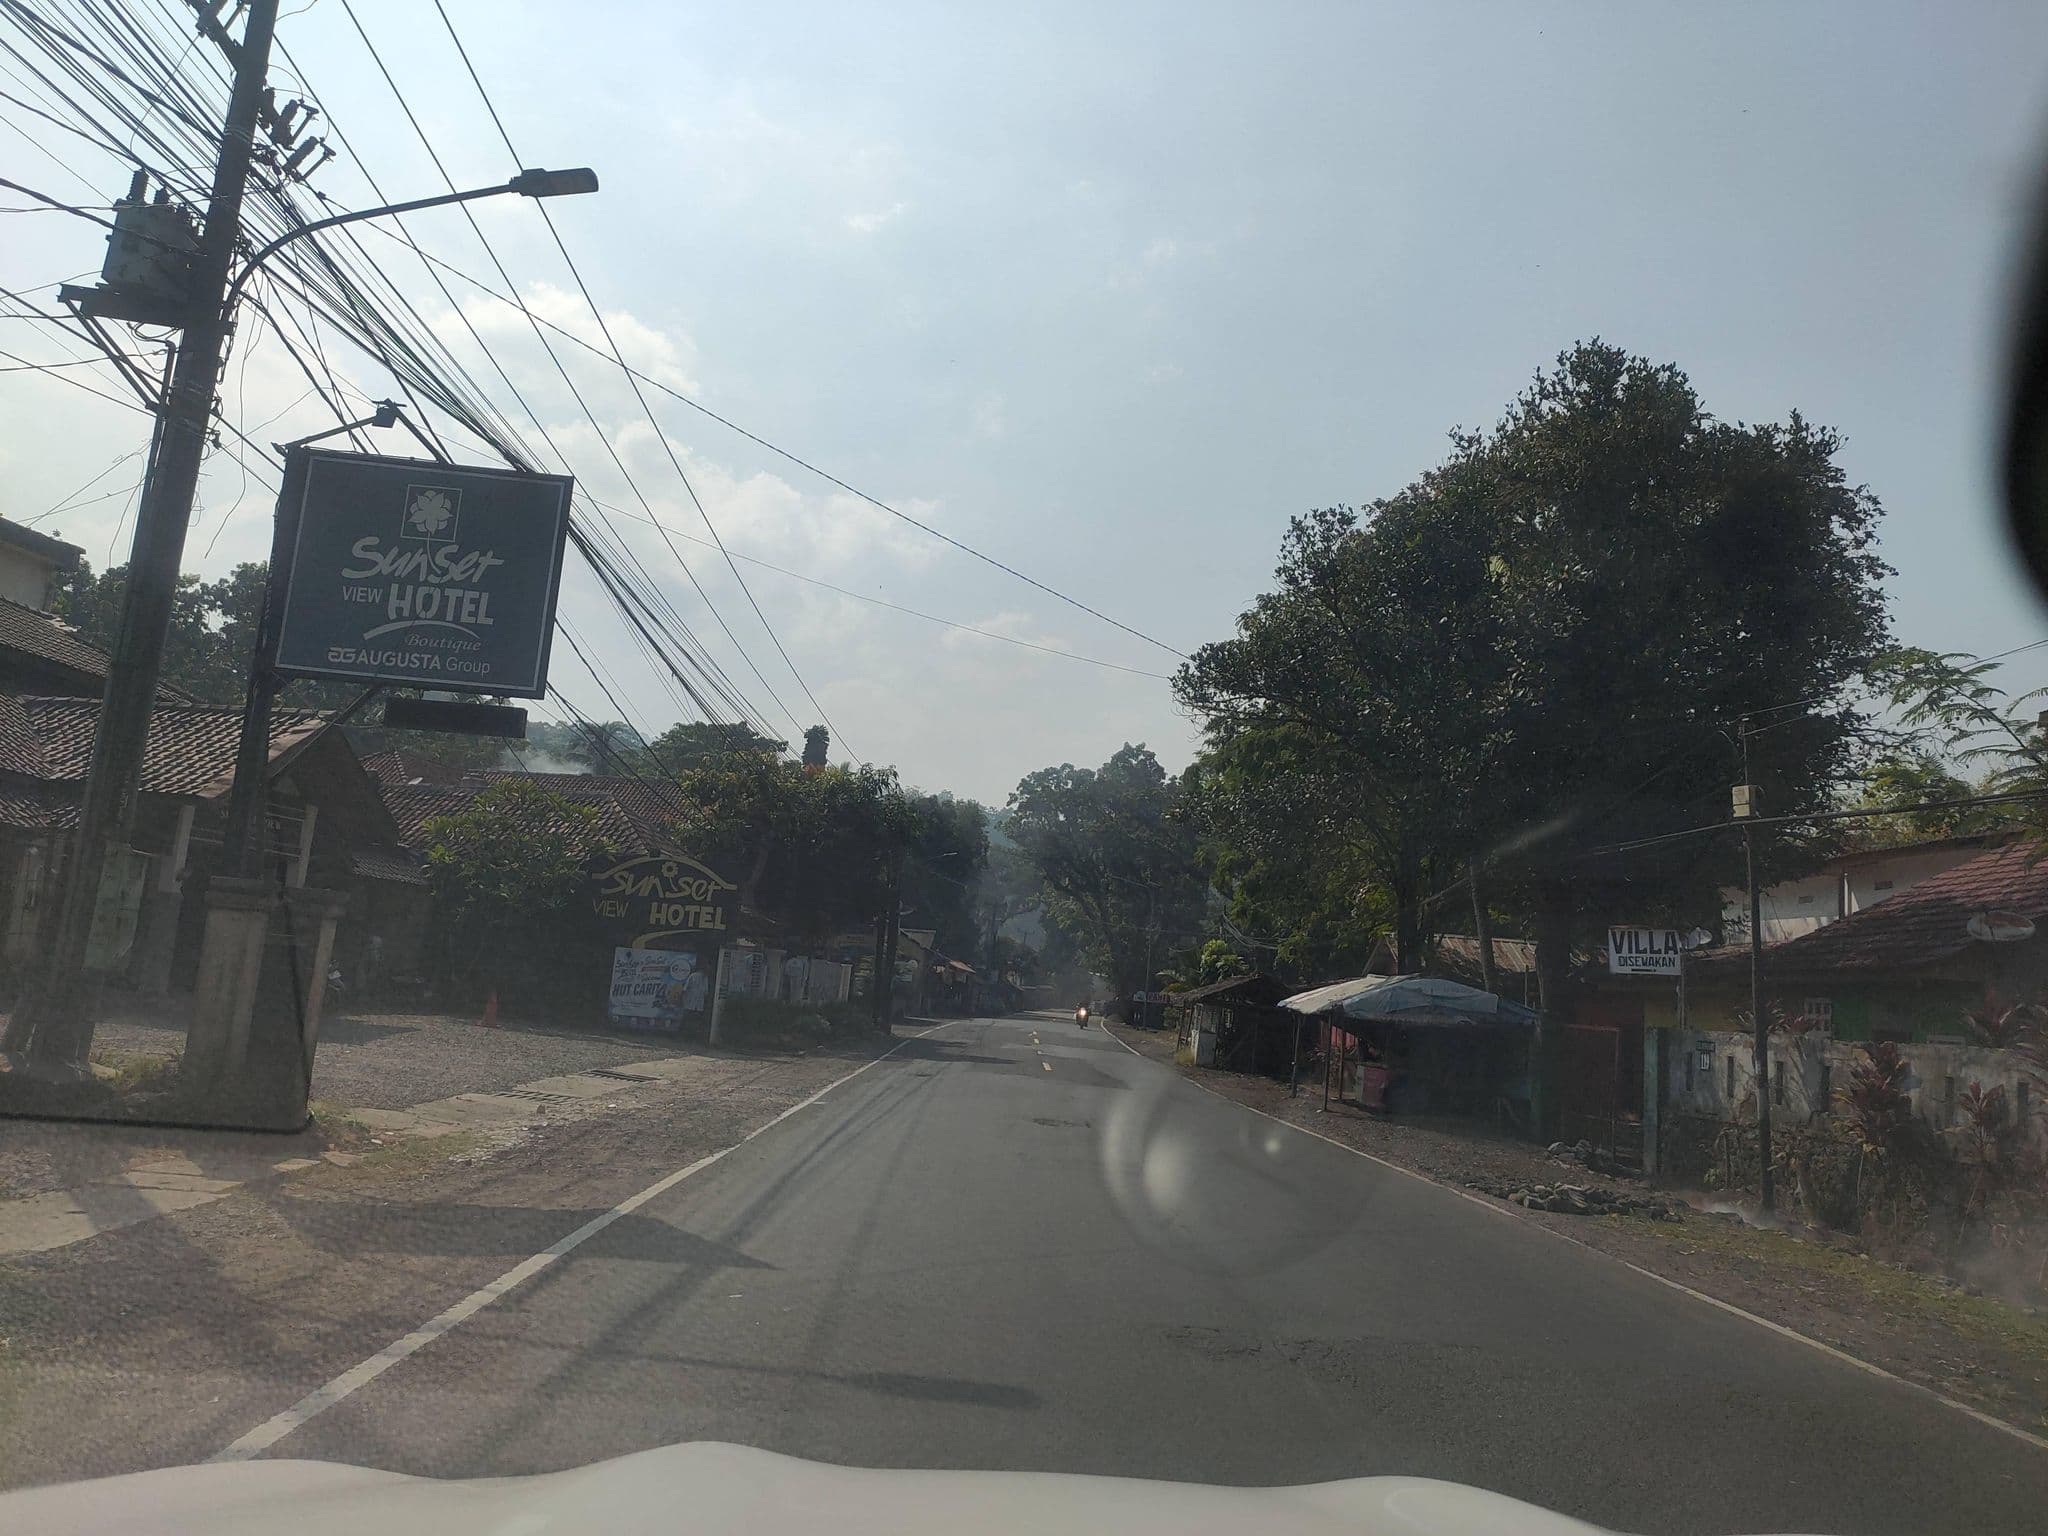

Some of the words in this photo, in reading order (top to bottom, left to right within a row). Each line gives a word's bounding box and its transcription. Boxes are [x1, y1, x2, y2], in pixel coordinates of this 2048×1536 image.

[342, 585, 383, 604] VIEW
[387, 583, 494, 625] HOTEL
[406, 633, 482, 653] Boutique
[357, 651, 441, 670] AUGUSTA
[446, 657, 490, 677] Group
[592, 898, 630, 919] VIEW
[650, 902, 727, 930] HOTEL
[1611, 931, 1679, 955] VILLA
[1618, 956, 1676, 967] DISEWAKAN
